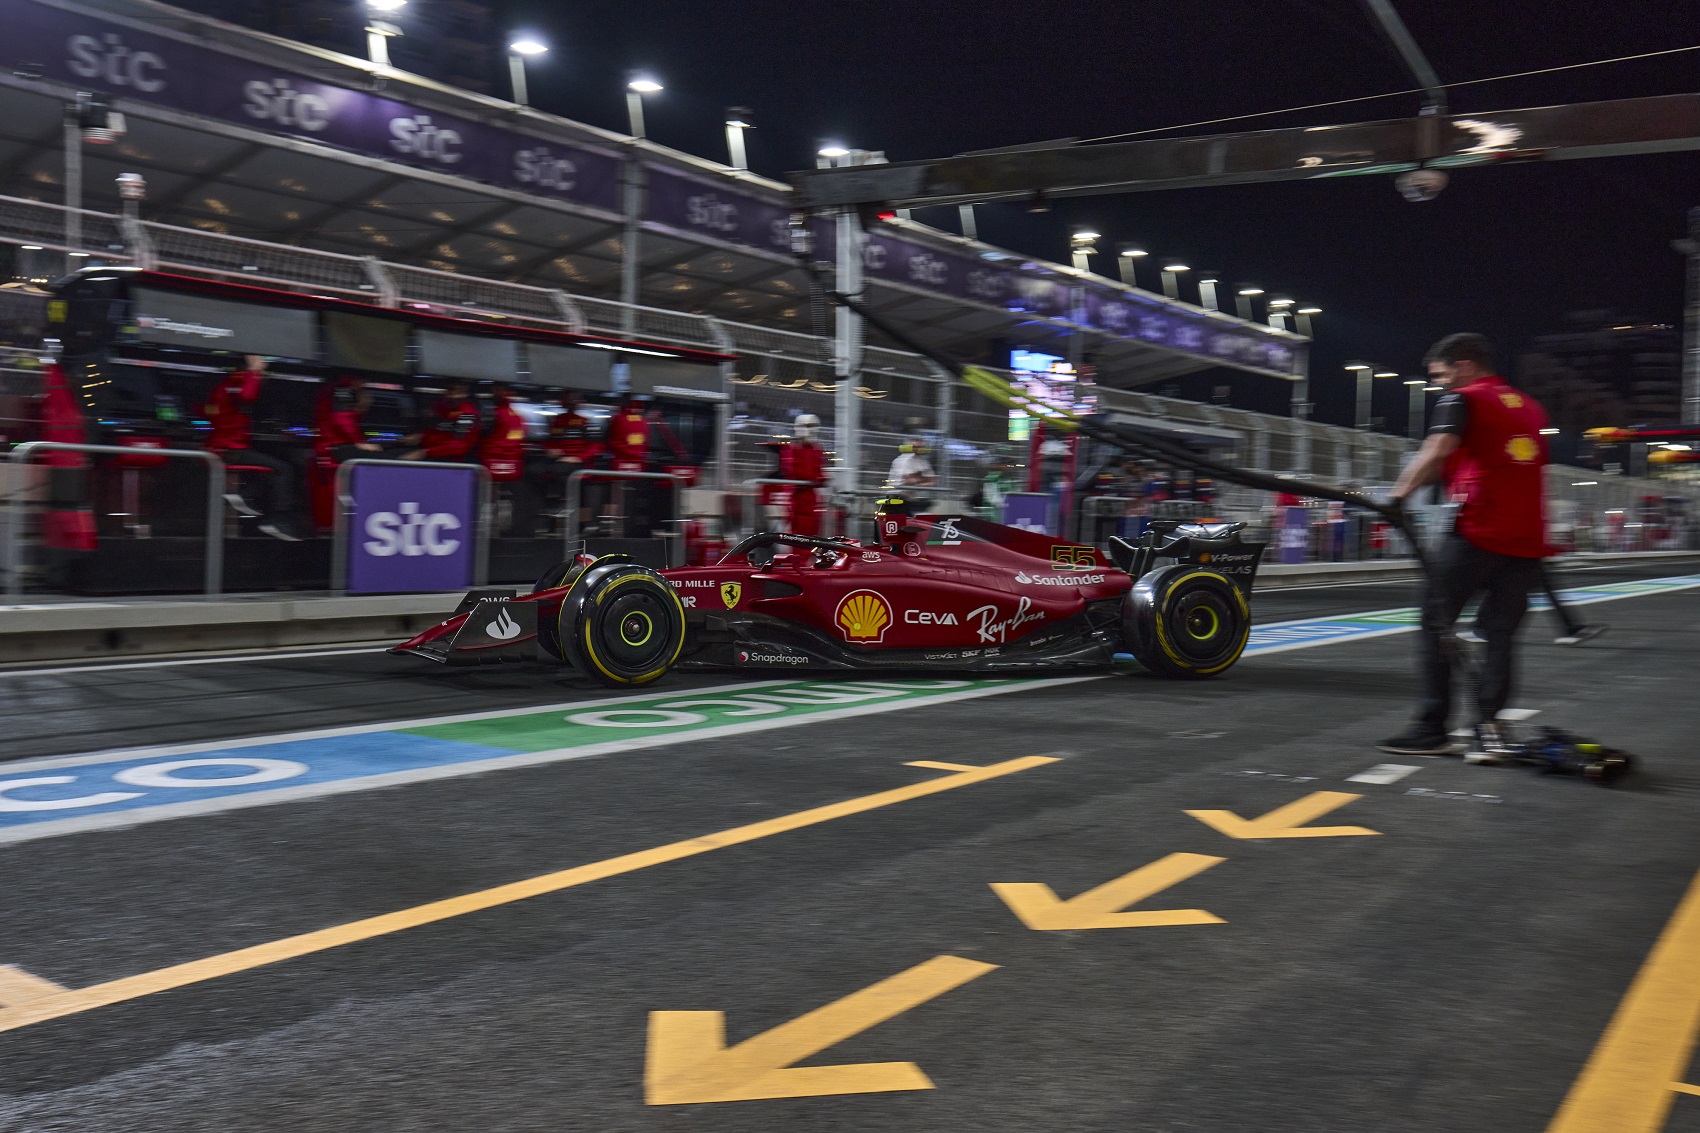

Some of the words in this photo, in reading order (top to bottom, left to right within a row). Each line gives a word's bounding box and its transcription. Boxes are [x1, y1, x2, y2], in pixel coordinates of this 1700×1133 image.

[67, 34, 166, 93] stc
[243, 79, 329, 131] stc
[389, 116, 462, 164] stc
[513, 148, 577, 191] stc
[364, 502, 462, 557] stc
[862, 551, 881, 559] aws
[1051, 545, 1096, 571] 55
[1211, 553, 1255, 562] V-Power
[685, 580, 715, 588] MILLE
[1034, 573, 1106, 586] Santander
[966, 596, 1046, 644] Ray-Ban
[751, 653, 809, 664] Snapdragon
